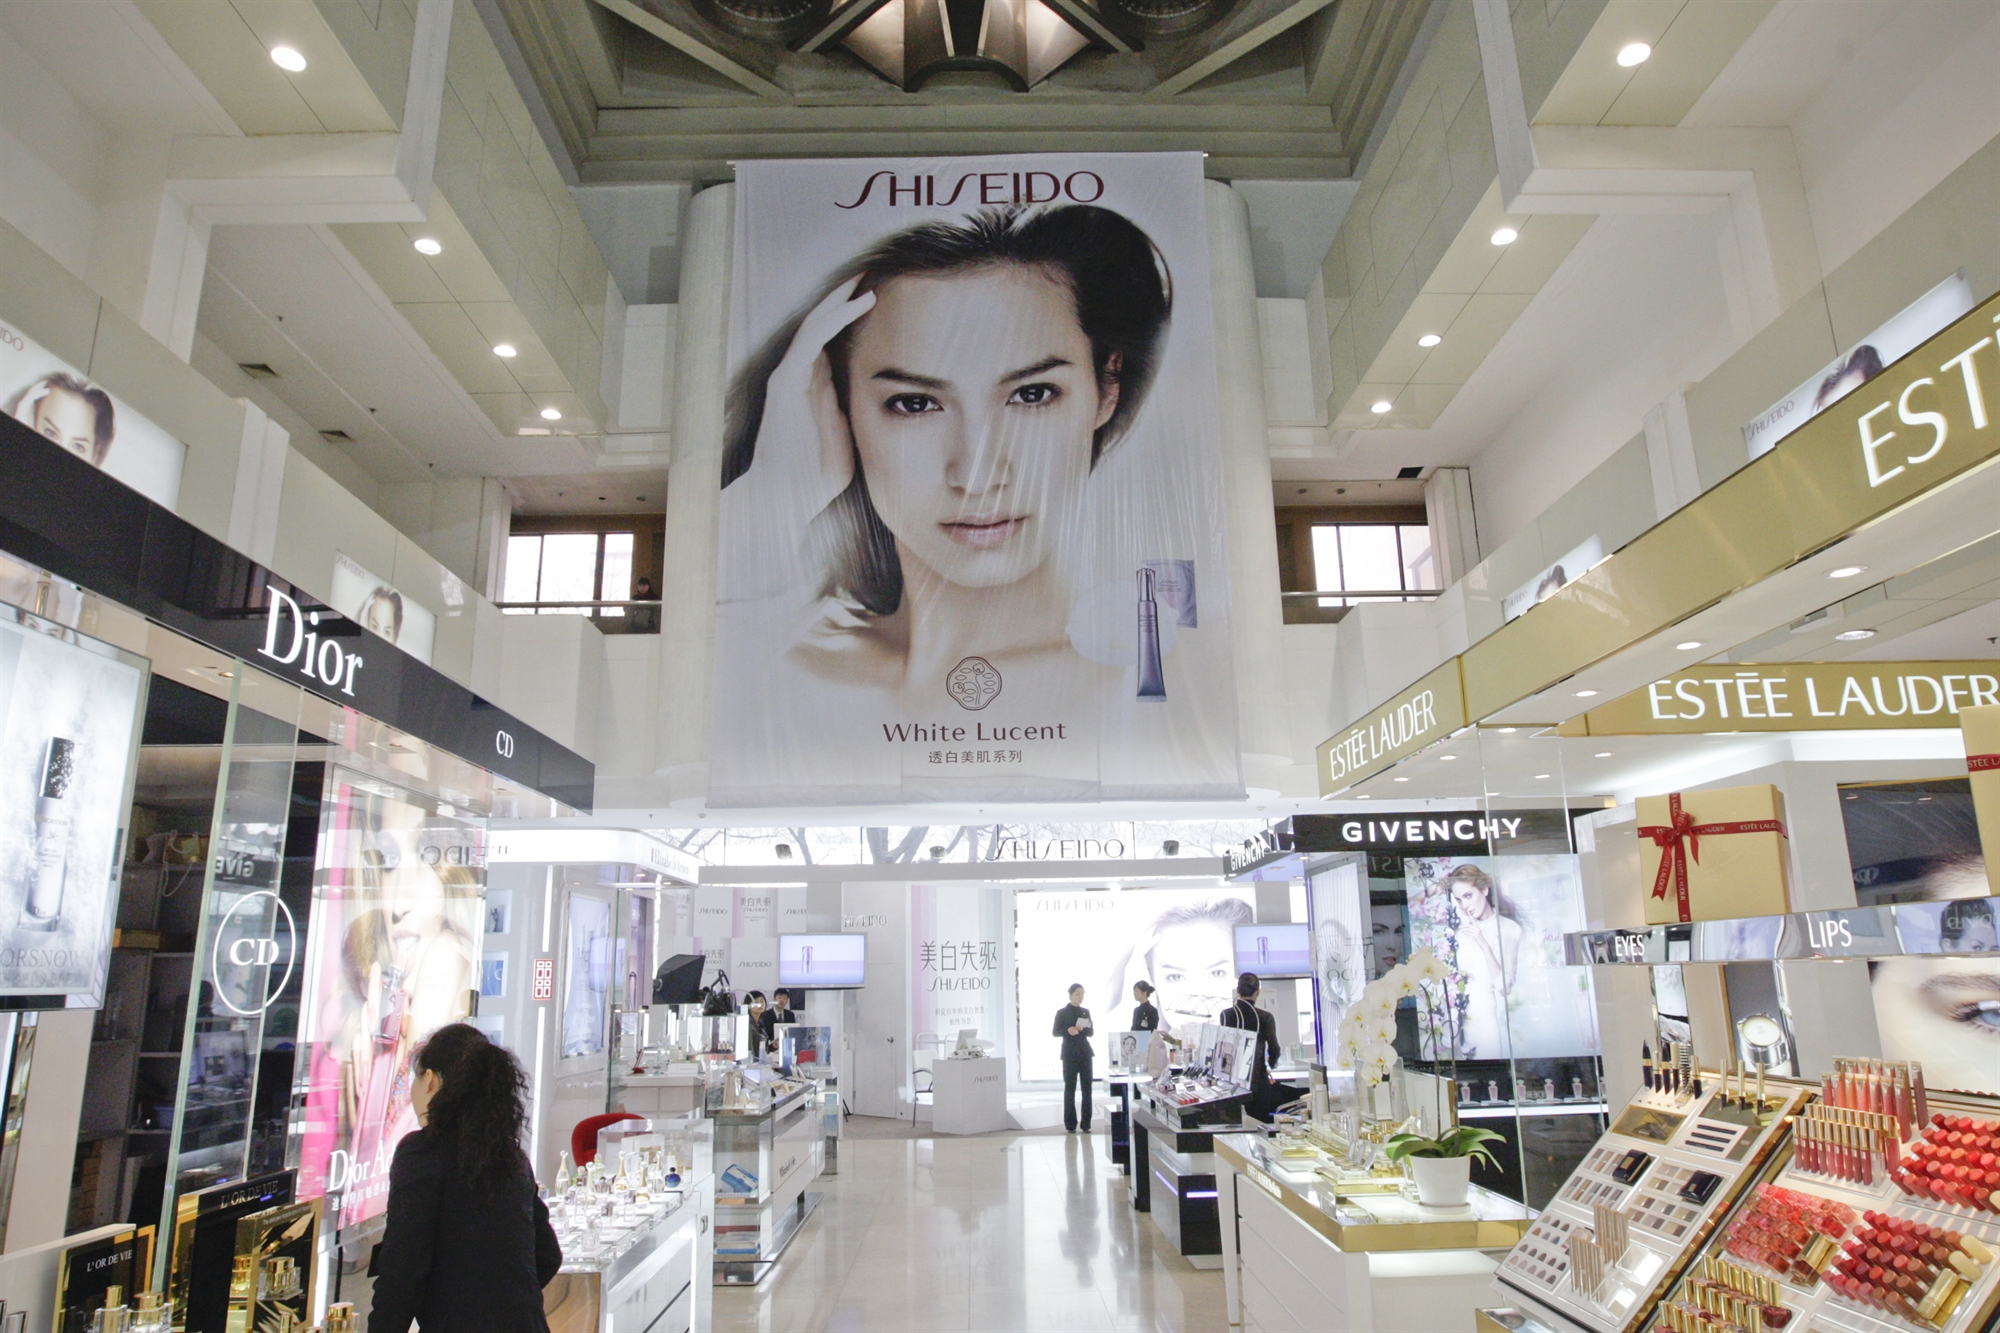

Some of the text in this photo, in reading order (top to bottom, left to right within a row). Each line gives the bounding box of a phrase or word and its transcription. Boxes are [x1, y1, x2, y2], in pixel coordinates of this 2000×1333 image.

[834, 170, 1105, 209] SHISEIDO
[1857, 313, 2000, 488] EST
[1748, 400, 1795, 441] SHISEIDO
[257, 585, 363, 697] Dior
[1805, 675, 2000, 716] LAUDER
[882, 722, 1067, 742] White Lucent
[1370, 689, 1437, 760] LAUDER
[496, 730, 514, 758] CD
[928, 750, 1022, 764] 透白美肌系列
[1341, 817, 1522, 844] GIVENCHY
[986, 838, 1125, 861] SHISEIDO
[1230, 841, 1265, 871] GIVENCHY
[699, 907, 728, 915] SHISEIDO
[1031, 898, 1114, 912] SHISEIDO
[1614, 933, 1645, 957] EYES
[1807, 914, 1852, 949] LIPS
[229, 938, 280, 966] CD
[927, 977, 991, 992] SHISEIDO
[326, 1149, 371, 1193] Dior
[86, 1249, 133, 1272] L'OR DE VIE
